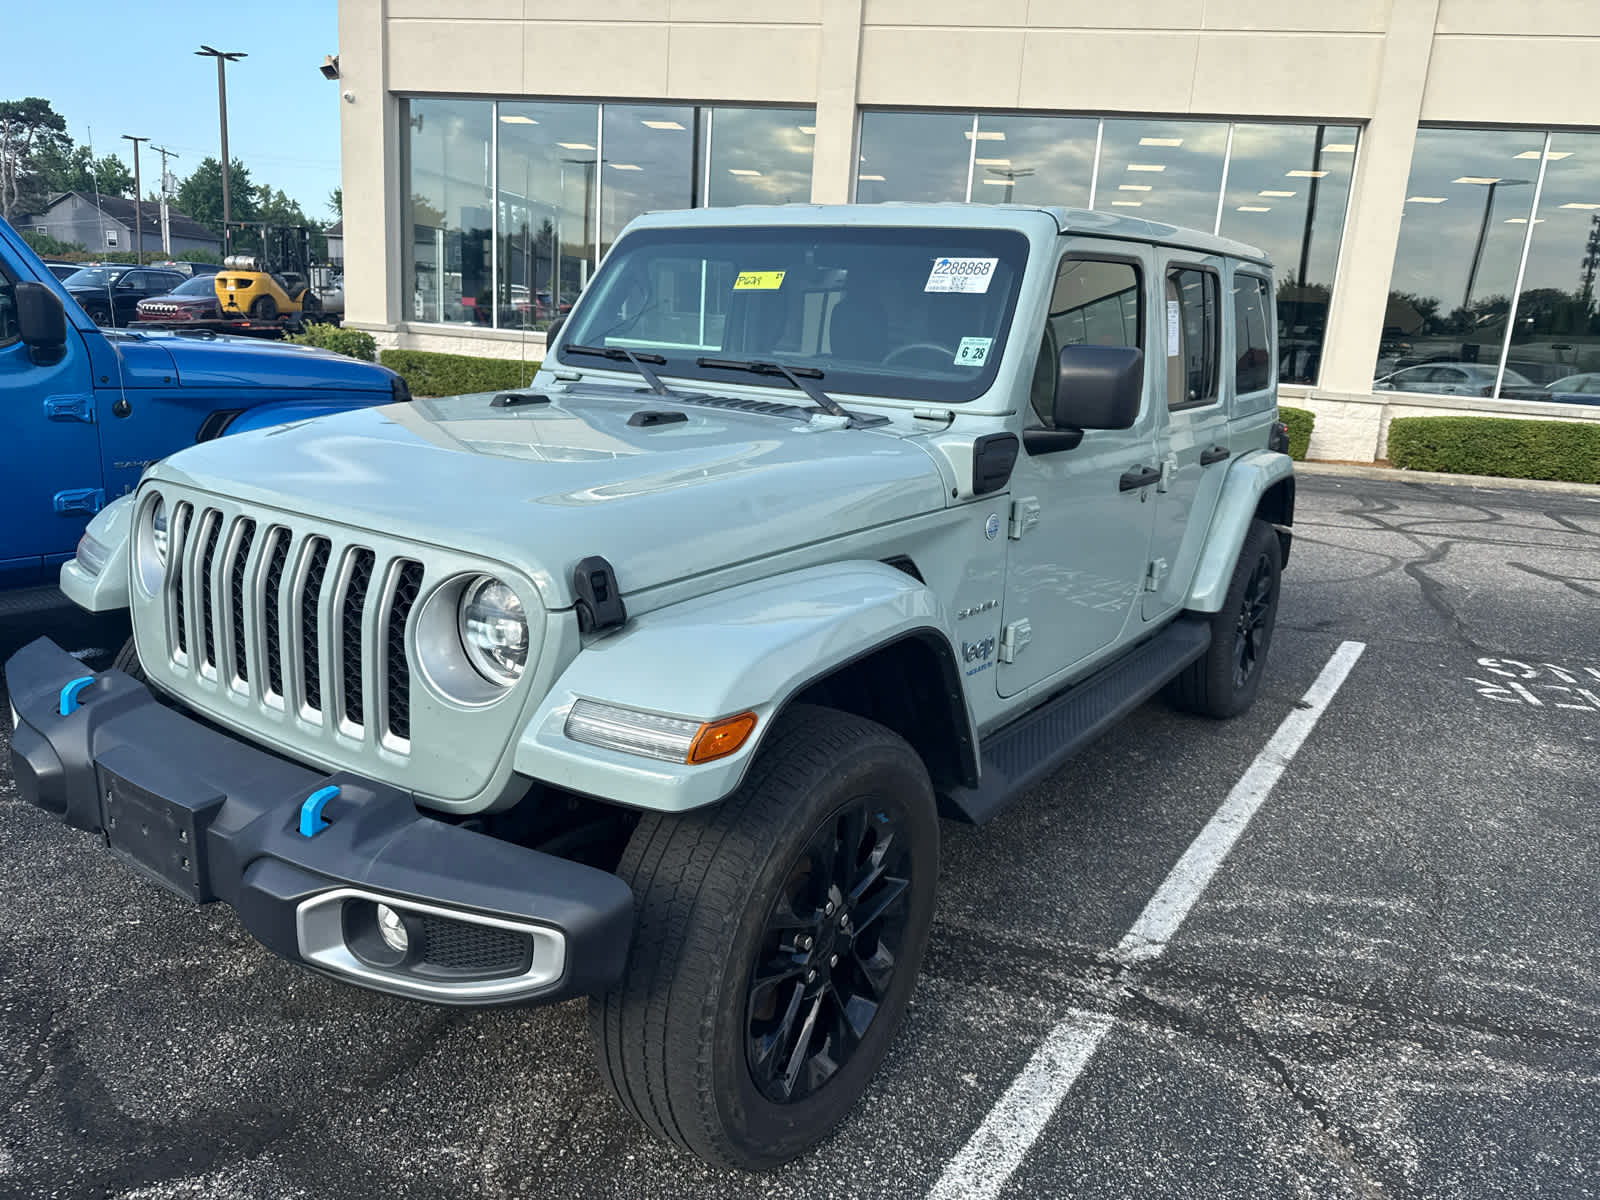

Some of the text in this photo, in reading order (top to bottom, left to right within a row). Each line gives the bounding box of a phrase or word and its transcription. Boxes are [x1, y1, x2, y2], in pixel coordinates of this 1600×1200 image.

[934, 261, 992, 276] 2288868
[961, 346, 985, 360] 6 28
[961, 636, 995, 663] Jeep
